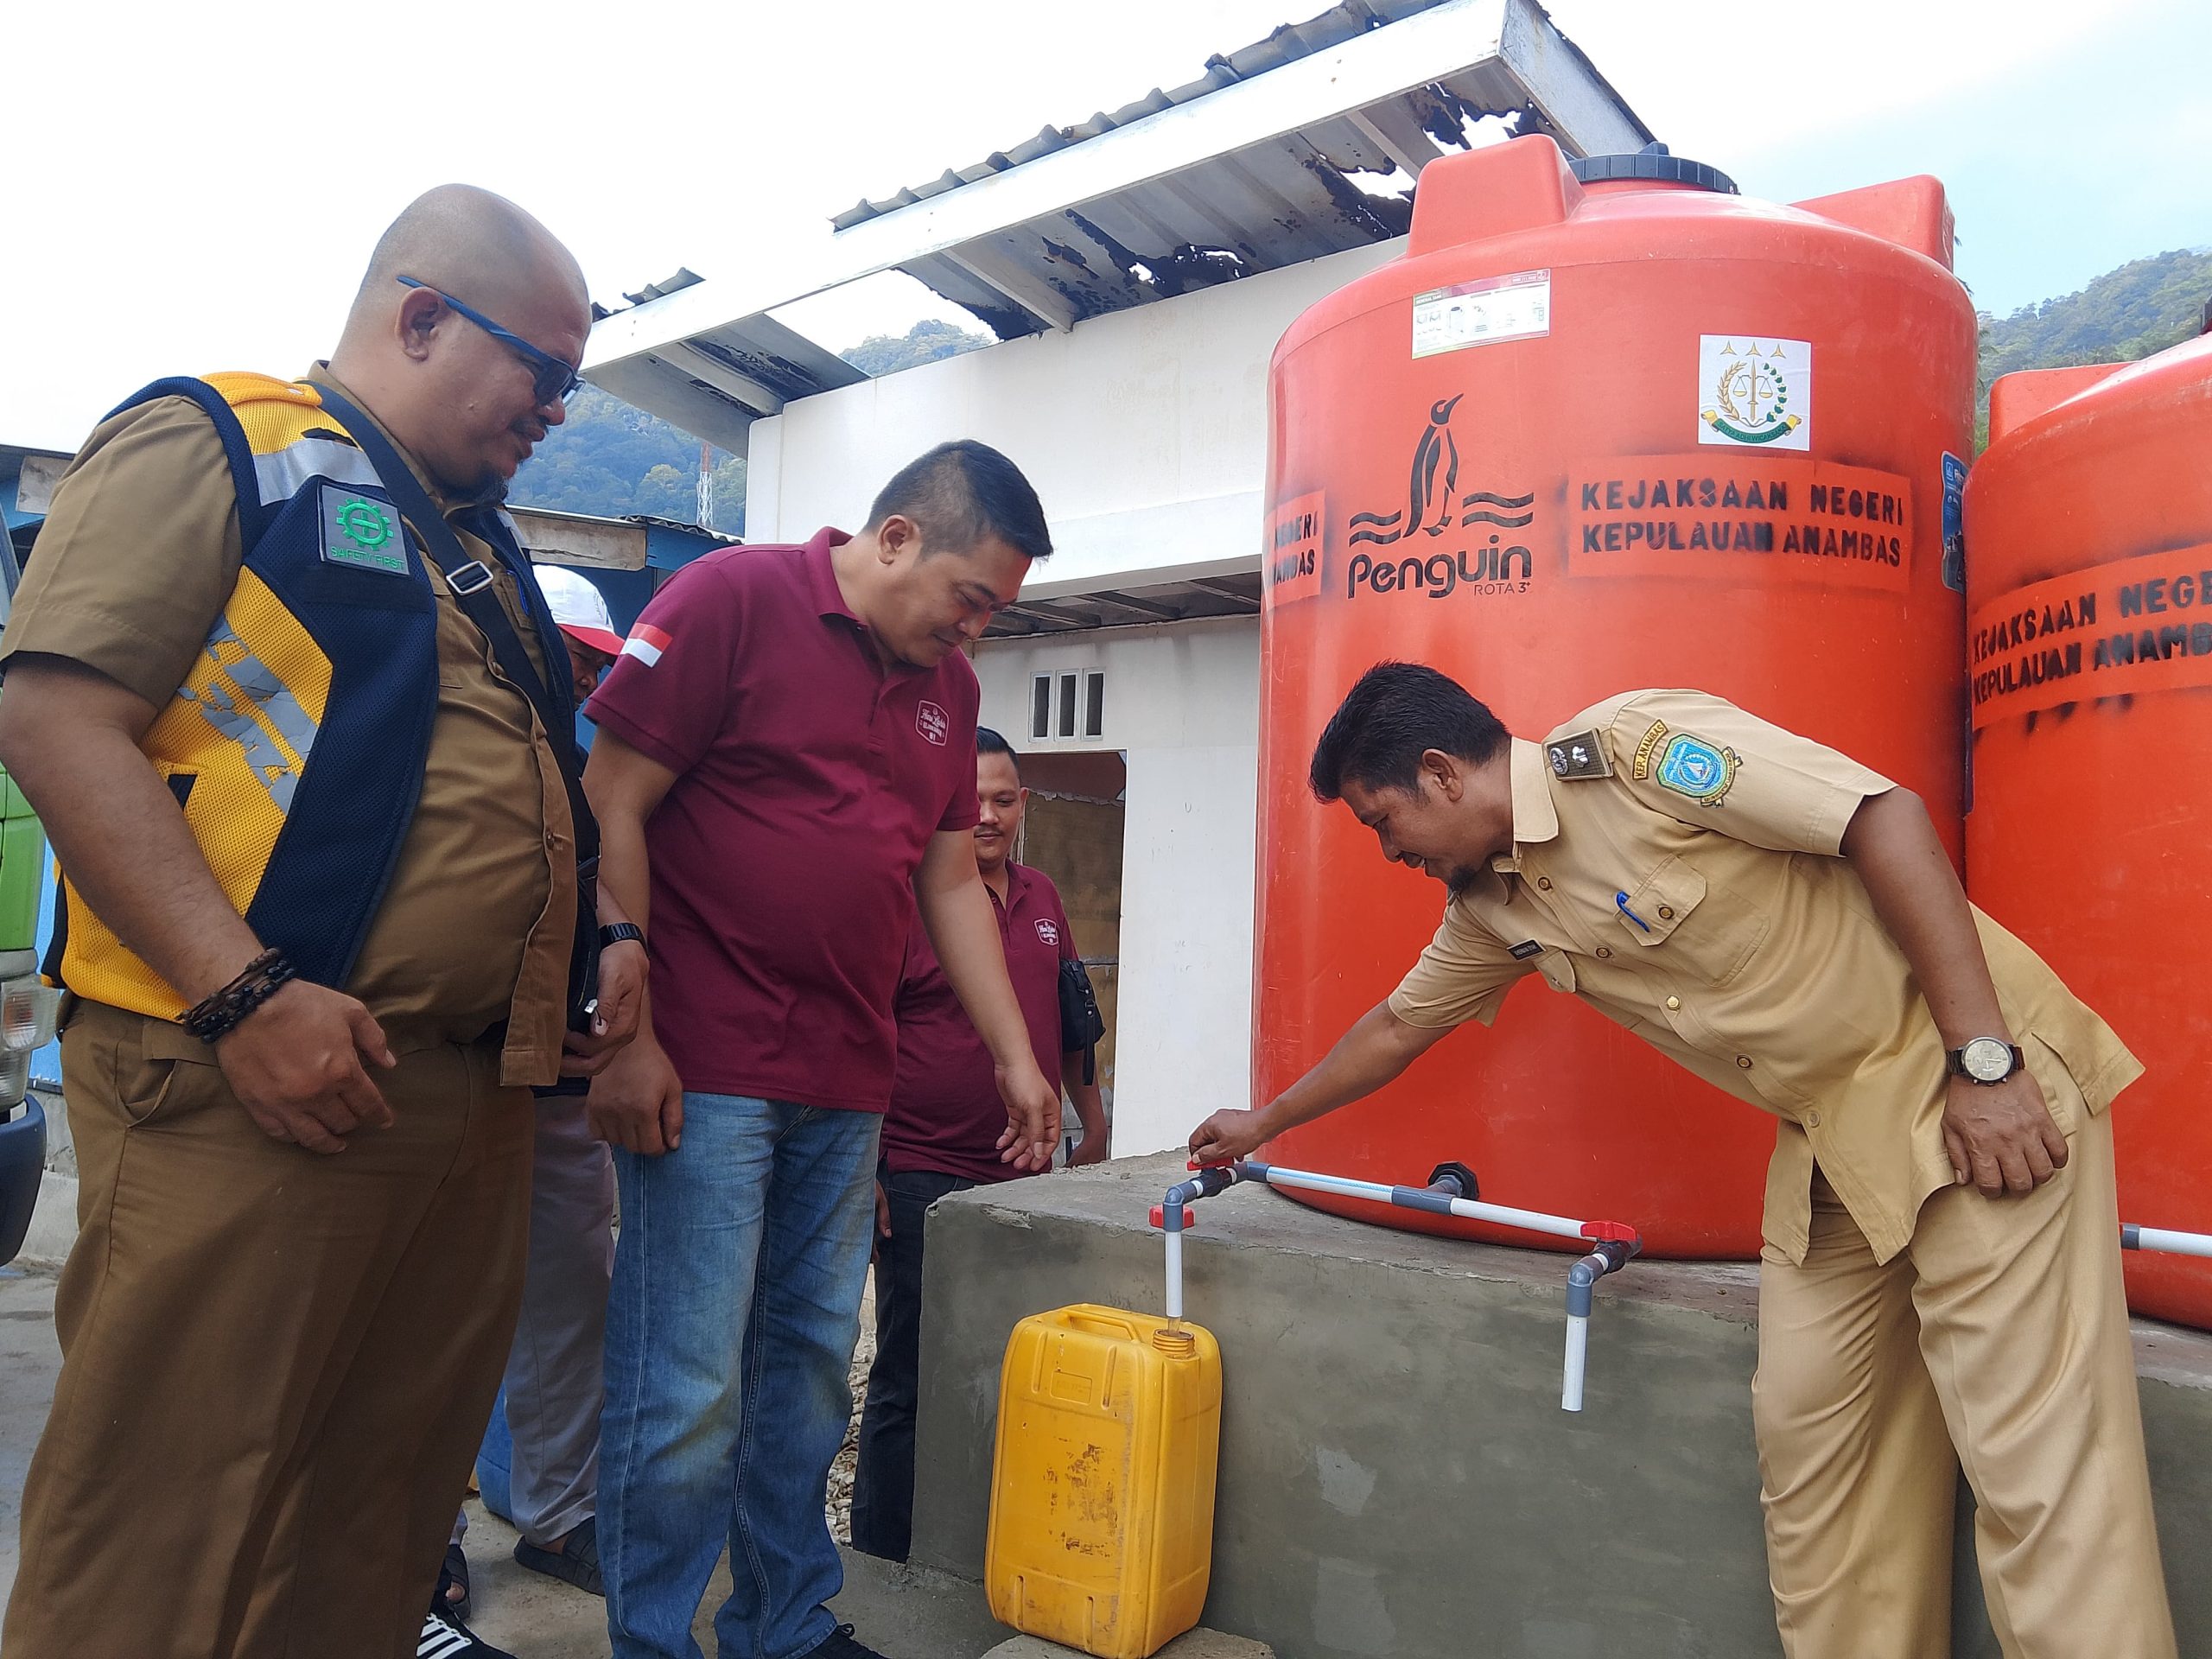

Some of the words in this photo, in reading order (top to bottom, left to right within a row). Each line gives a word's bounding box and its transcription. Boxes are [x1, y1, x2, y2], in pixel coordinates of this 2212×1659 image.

[1582, 478, 1787, 512] KEJAKSAAN
[1810, 484, 1904, 526] NEGERI
[331, 546, 373, 562] SAFETY
[374, 554, 405, 569] FIRST
[1348, 534, 1532, 600] Penguin
[1582, 521, 1775, 554] KEPULAUAN
[1783, 524, 1901, 568] ANAMBAS
[1474, 582, 1515, 596] ROTA
[1974, 592, 2096, 665] KEJAKSAAN
[1974, 642, 2082, 707] KEPULAUAN
